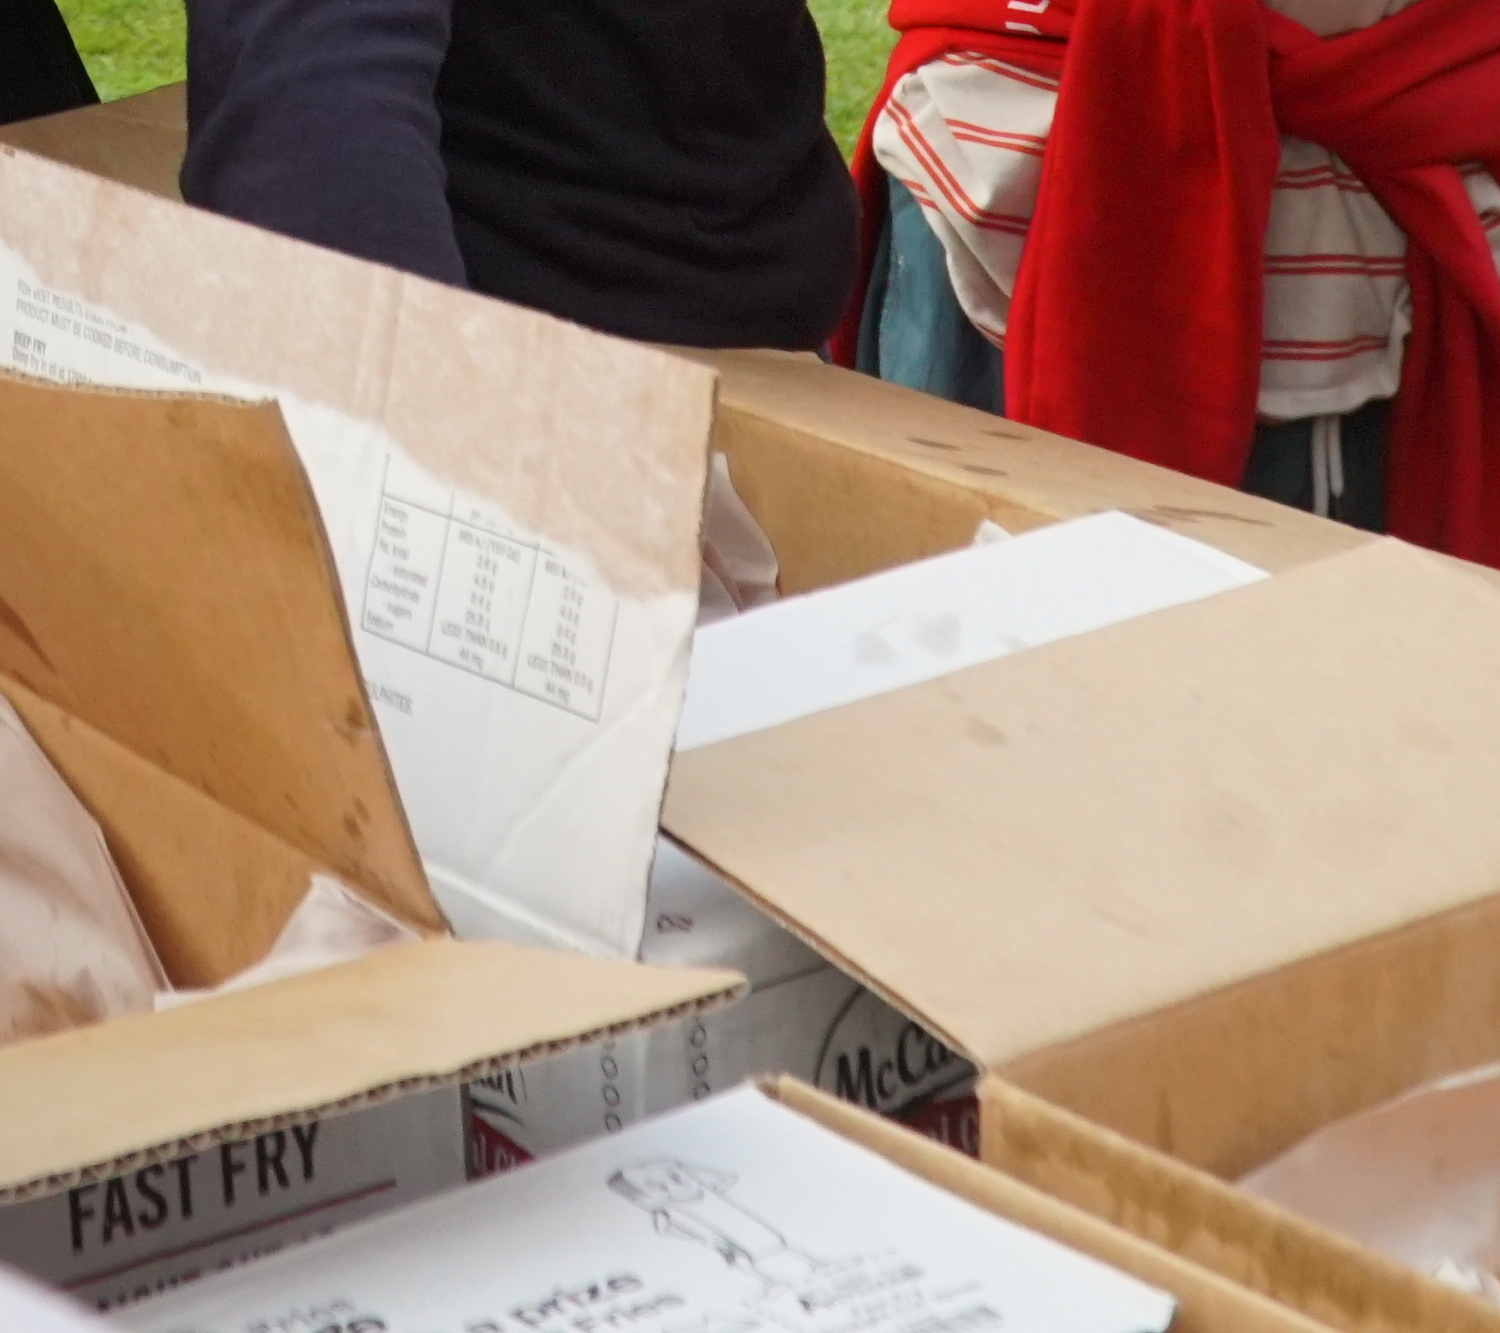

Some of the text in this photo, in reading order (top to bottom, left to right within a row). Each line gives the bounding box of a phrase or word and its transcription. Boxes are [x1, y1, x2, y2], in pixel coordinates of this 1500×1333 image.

[14, 329, 47, 357] DEEP FRY
[16, 298, 49, 324] PRODUCT
[51, 311, 72, 332] MUST
[73, 320, 82, 336] BE
[84, 323, 113, 350] COOKED
[114, 337, 143, 361] BEFORE
[836, 1020, 953, 1109] McCa
[67, 1121, 320, 1253] FAST FRY
